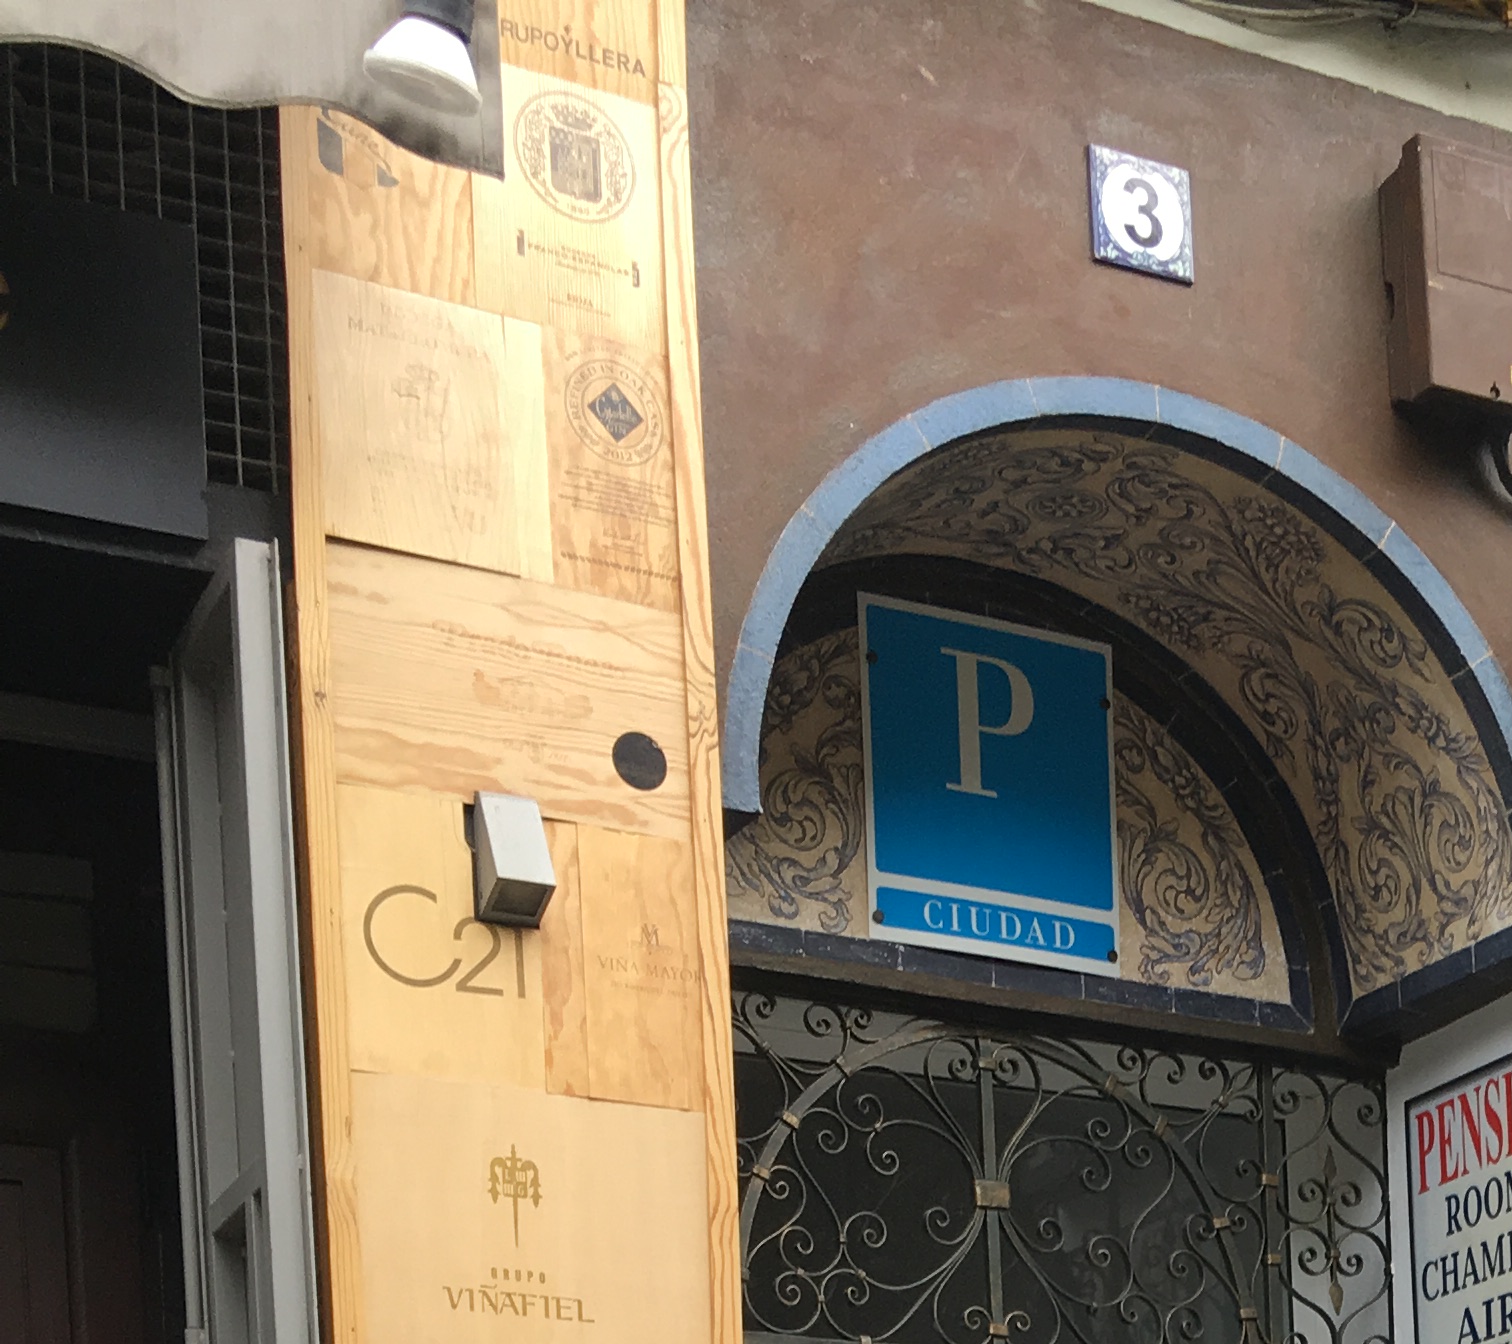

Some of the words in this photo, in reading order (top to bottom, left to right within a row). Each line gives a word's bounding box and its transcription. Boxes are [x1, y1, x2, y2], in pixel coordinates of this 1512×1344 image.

[1121, 176, 1165, 249] 3
[939, 645, 1035, 799] P
[922, 899, 1077, 951] CIUDAD
[490, 1266, 547, 1285] GRUPO
[441, 1283, 596, 1324] VIÑAFIEL
